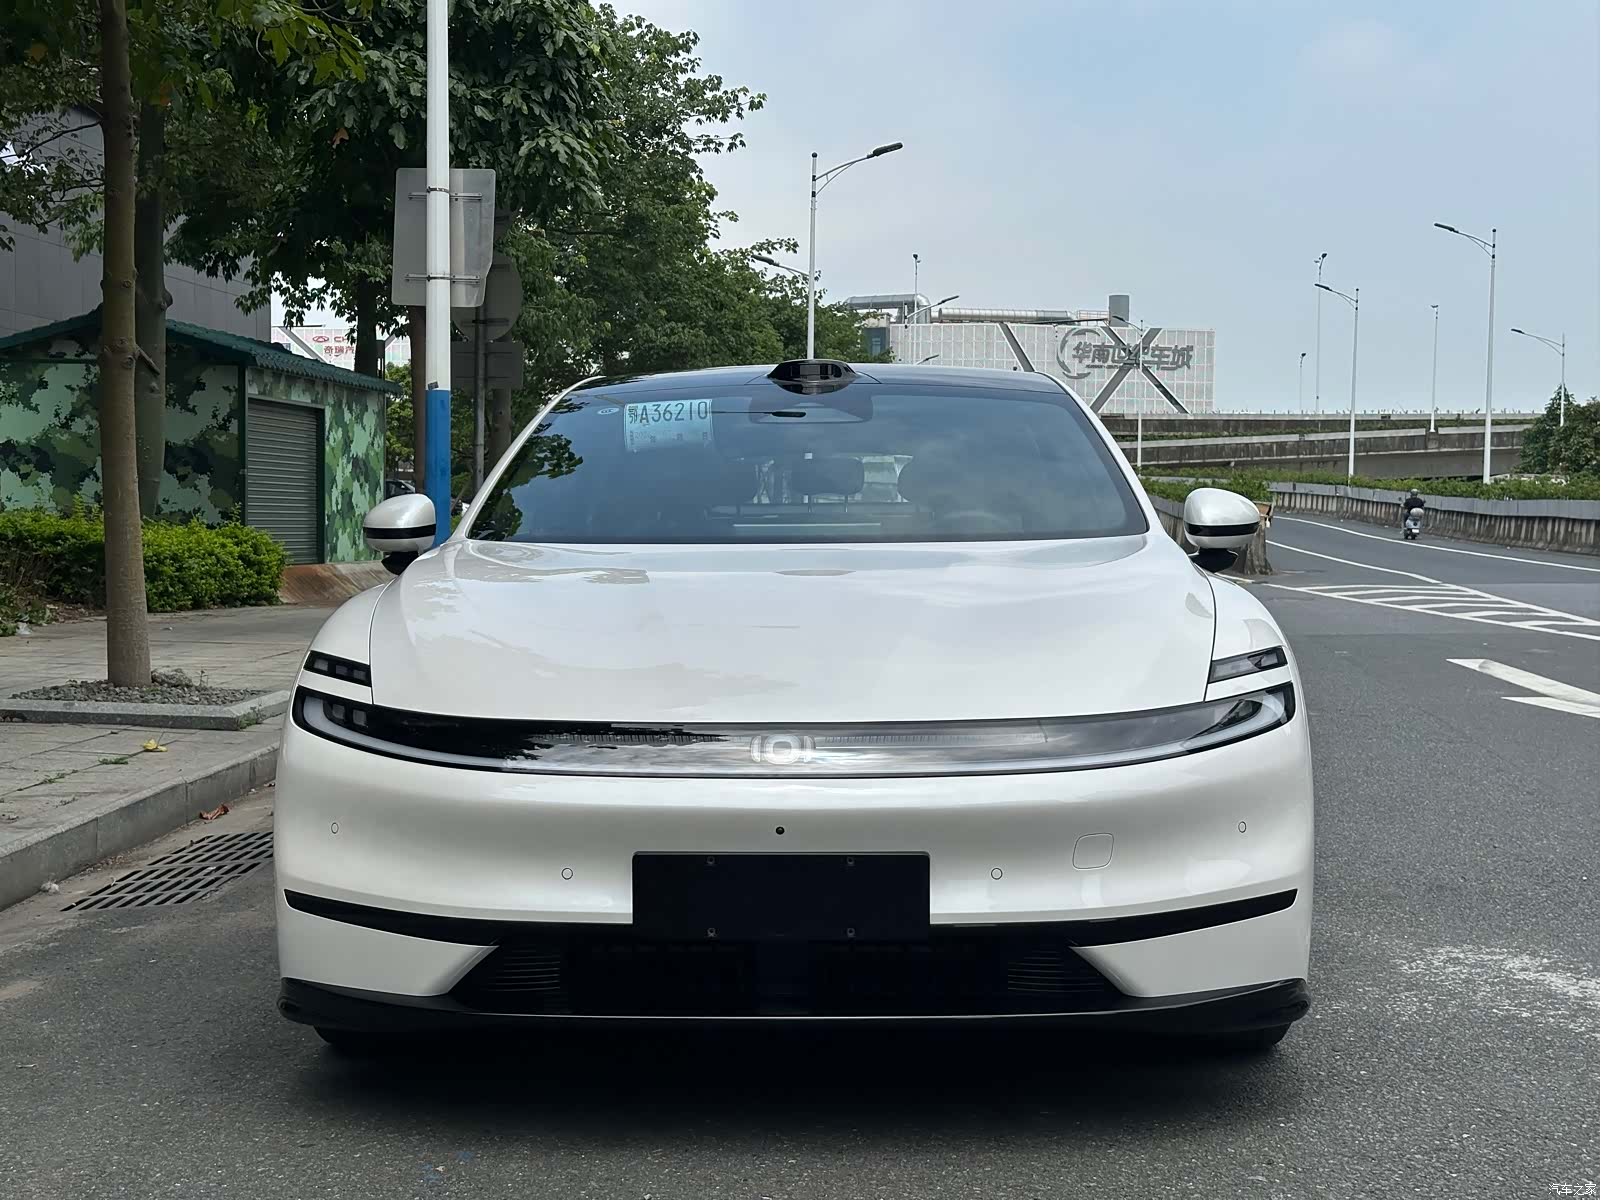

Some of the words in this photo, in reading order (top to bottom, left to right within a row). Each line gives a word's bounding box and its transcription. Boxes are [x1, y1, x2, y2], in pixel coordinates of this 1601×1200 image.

[1071, 341, 1194, 371] 华南世纪车城
[628, 401, 708, 424] 鄂A36210
